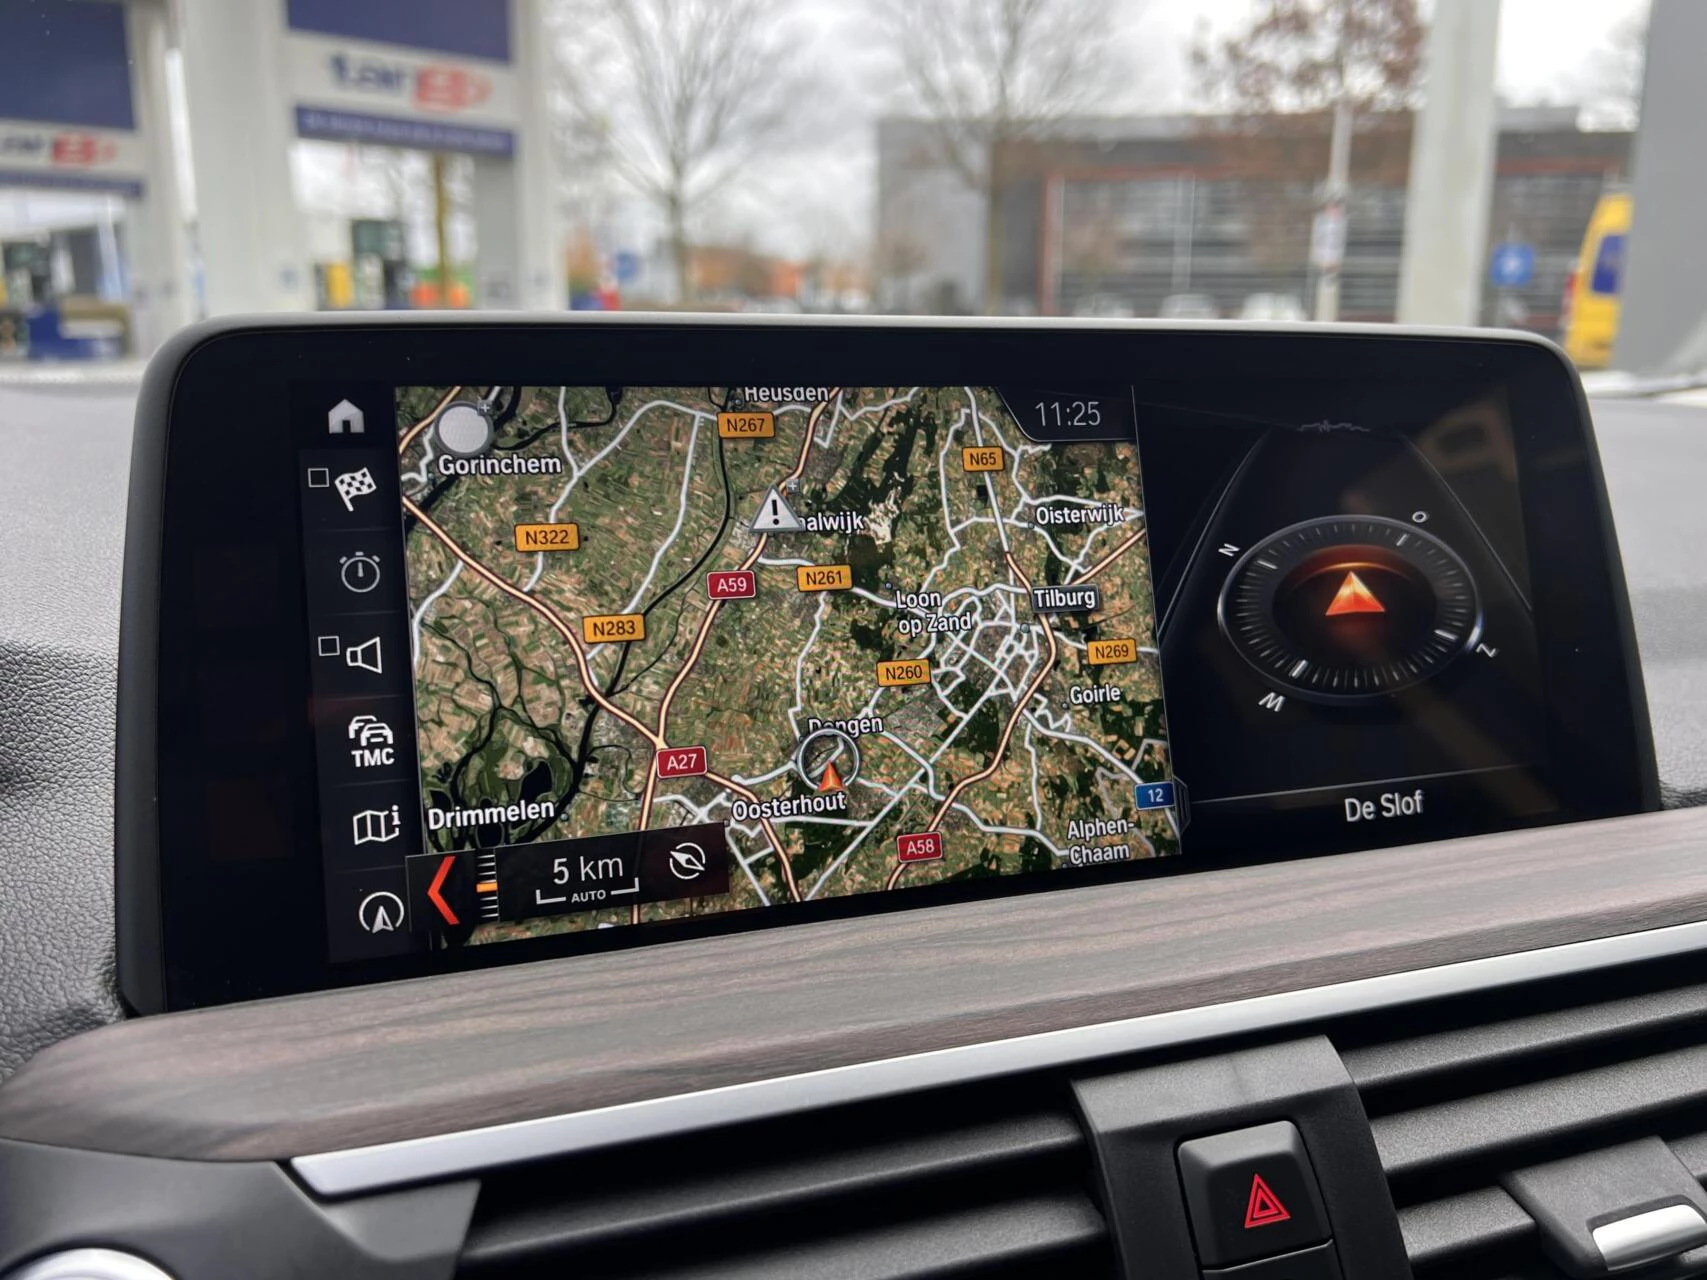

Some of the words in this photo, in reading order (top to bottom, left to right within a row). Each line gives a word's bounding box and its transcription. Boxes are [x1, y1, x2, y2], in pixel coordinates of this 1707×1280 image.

[744, 386, 829, 402] Heusden
[1034, 401, 1101, 427] 11:25
[726, 418, 765, 433] N267
[438, 455, 562, 476] Gorinchem
[969, 453, 997, 467] N65
[1036, 507, 1125, 527] Oisterwijk
[525, 531, 570, 545] N322
[717, 578, 747, 592] A59
[805, 571, 844, 585] N261
[895, 591, 942, 609] Loon
[1033, 588, 1096, 611] Tilburg
[592, 621, 636, 637] N283
[898, 617, 922, 636] op
[926, 612, 973, 632] Zand
[1095, 643, 1129, 658] N269
[885, 666, 922, 680] N260
[1070, 686, 1121, 706] Goirle
[351, 747, 395, 767] TMC
[667, 754, 698, 770] A27
[1147, 789, 1163, 802] 12
[732, 791, 846, 820] Oosterhout
[1345, 798, 1375, 822] De
[1381, 790, 1424, 818] Slof
[428, 801, 555, 830] Drimmelen
[1067, 820, 1134, 841] Alphen-
[906, 840, 935, 854] A58
[1070, 844, 1130, 864] Chaam
[553, 858, 570, 885] 5
[580, 855, 624, 880] km
[571, 890, 607, 903] AUTO
